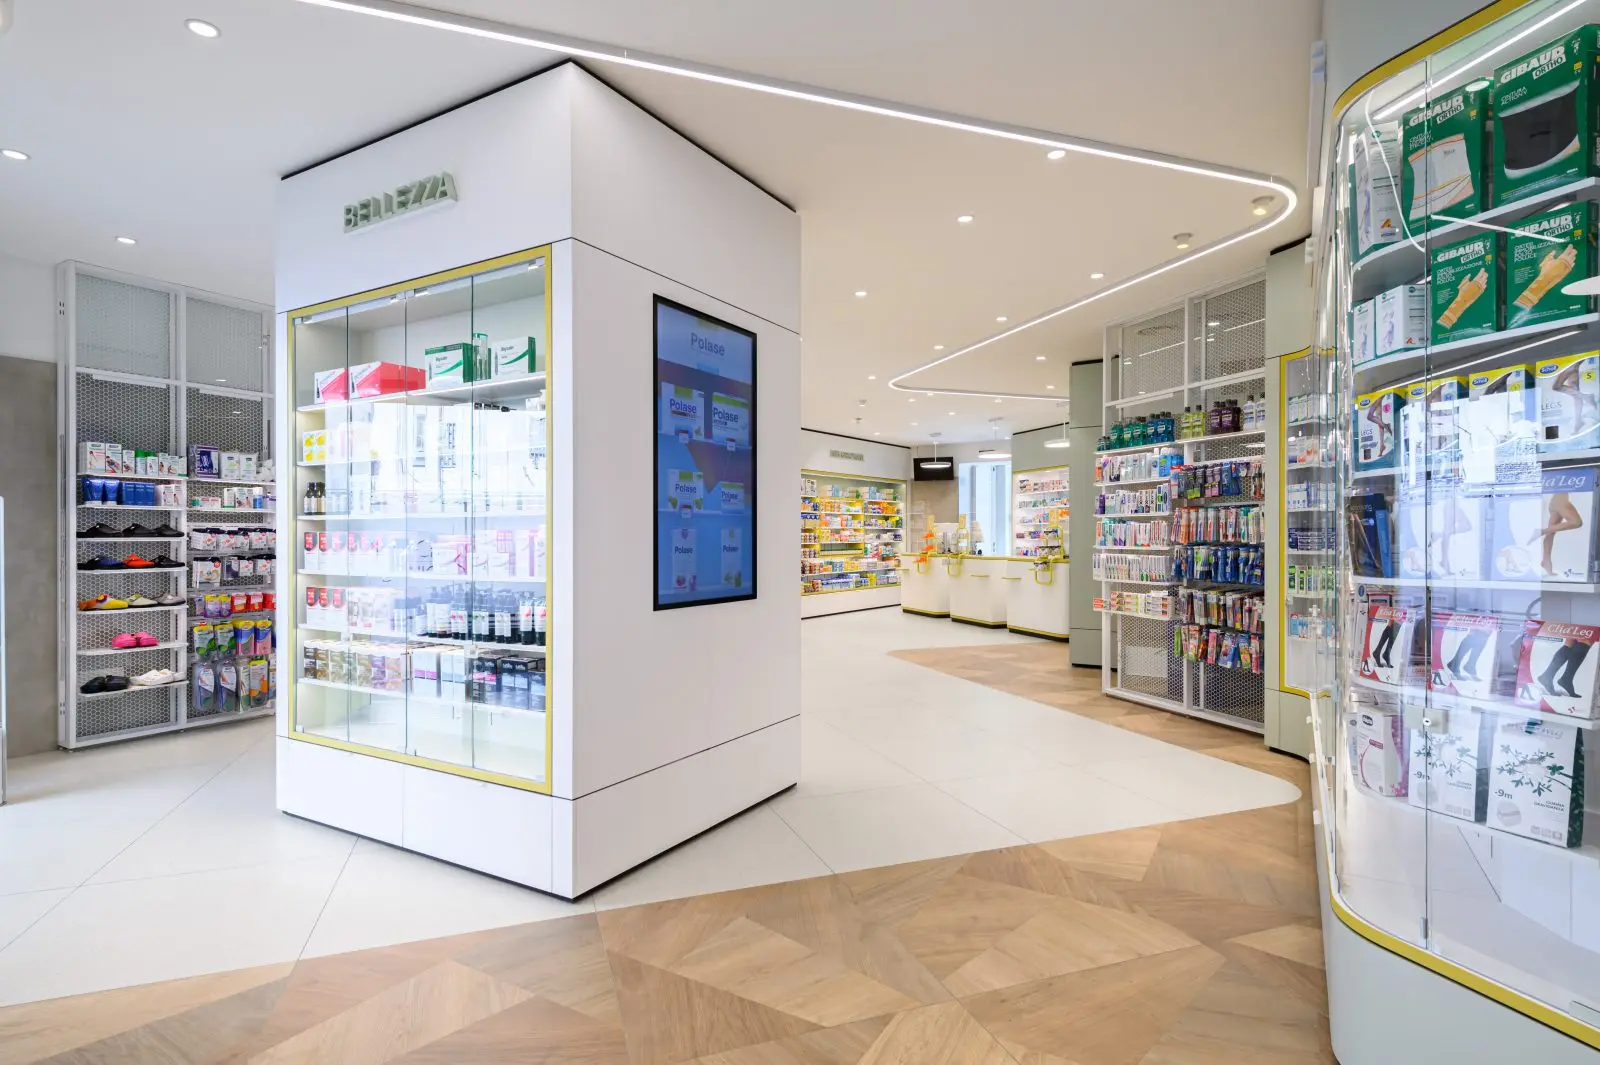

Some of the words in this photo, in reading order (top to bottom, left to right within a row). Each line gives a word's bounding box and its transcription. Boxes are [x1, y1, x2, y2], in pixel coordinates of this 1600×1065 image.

[1534, 56, 1563, 78] ORTHO
[1438, 104, 1462, 122] ORTHO
[343, 170, 458, 233] BELLEZZA
[1545, 223, 1571, 238] ORTHO
[1462, 249, 1483, 262] ORTHO
[690, 332, 725, 356] Polase
[669, 398, 697, 414] Polase
[1541, 402, 1562, 410] LEGS
[713, 407, 739, 423] Polase
[1360, 428, 1373, 436] LEGS
[1559, 475, 1585, 488] Leg
[675, 483, 697, 494] Polase
[721, 490, 738, 500] Polase
[674, 546, 693, 554] Polase
[722, 545, 739, 553] Polase
[1494, 788, 1513, 799] -9m
